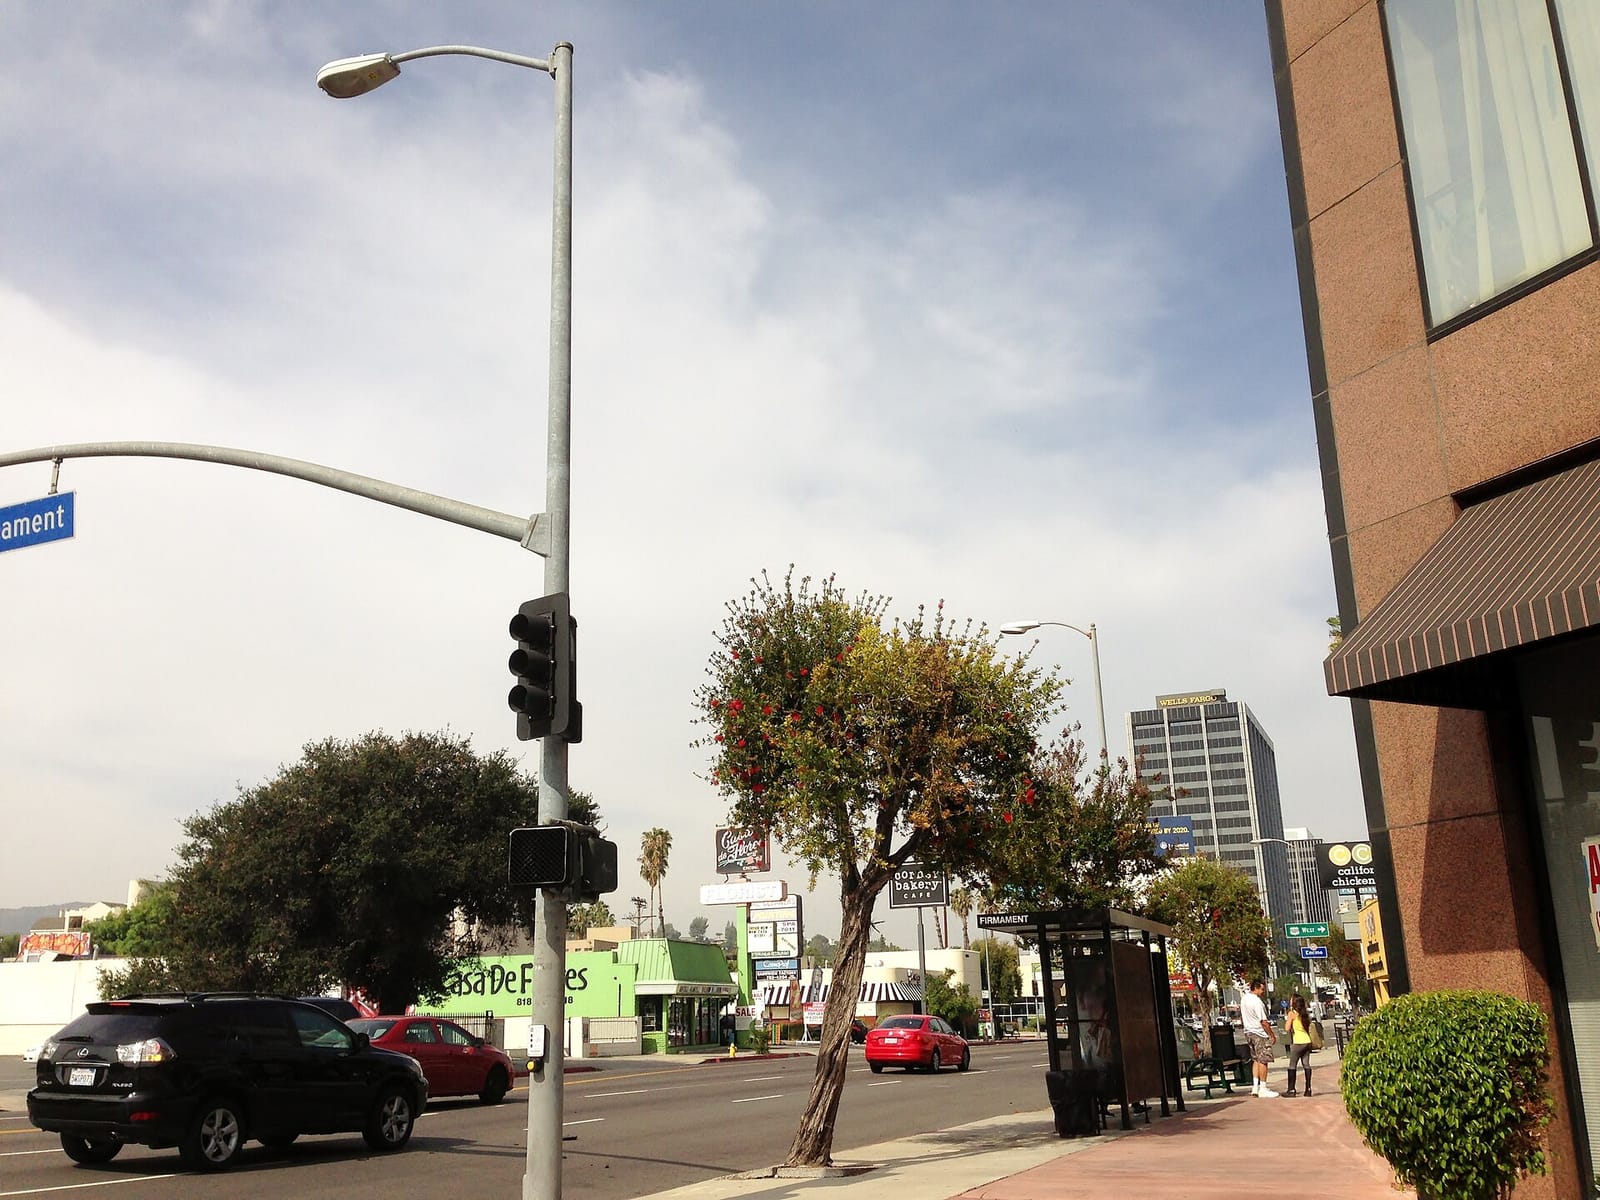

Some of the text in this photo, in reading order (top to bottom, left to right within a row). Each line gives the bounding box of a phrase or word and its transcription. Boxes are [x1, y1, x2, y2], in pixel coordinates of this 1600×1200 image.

[1, 504, 64, 540] ament
[1160, 695, 1218, 706] WELLS FARGO
[895, 880, 939, 890] bakery
[1332, 876, 1376, 886] chicken
[903, 891, 931, 899] CAFE
[980, 914, 1029, 925] FIRMAMENT
[516, 997, 532, 1006] 818
[735, 1007, 756, 1017] SALE
